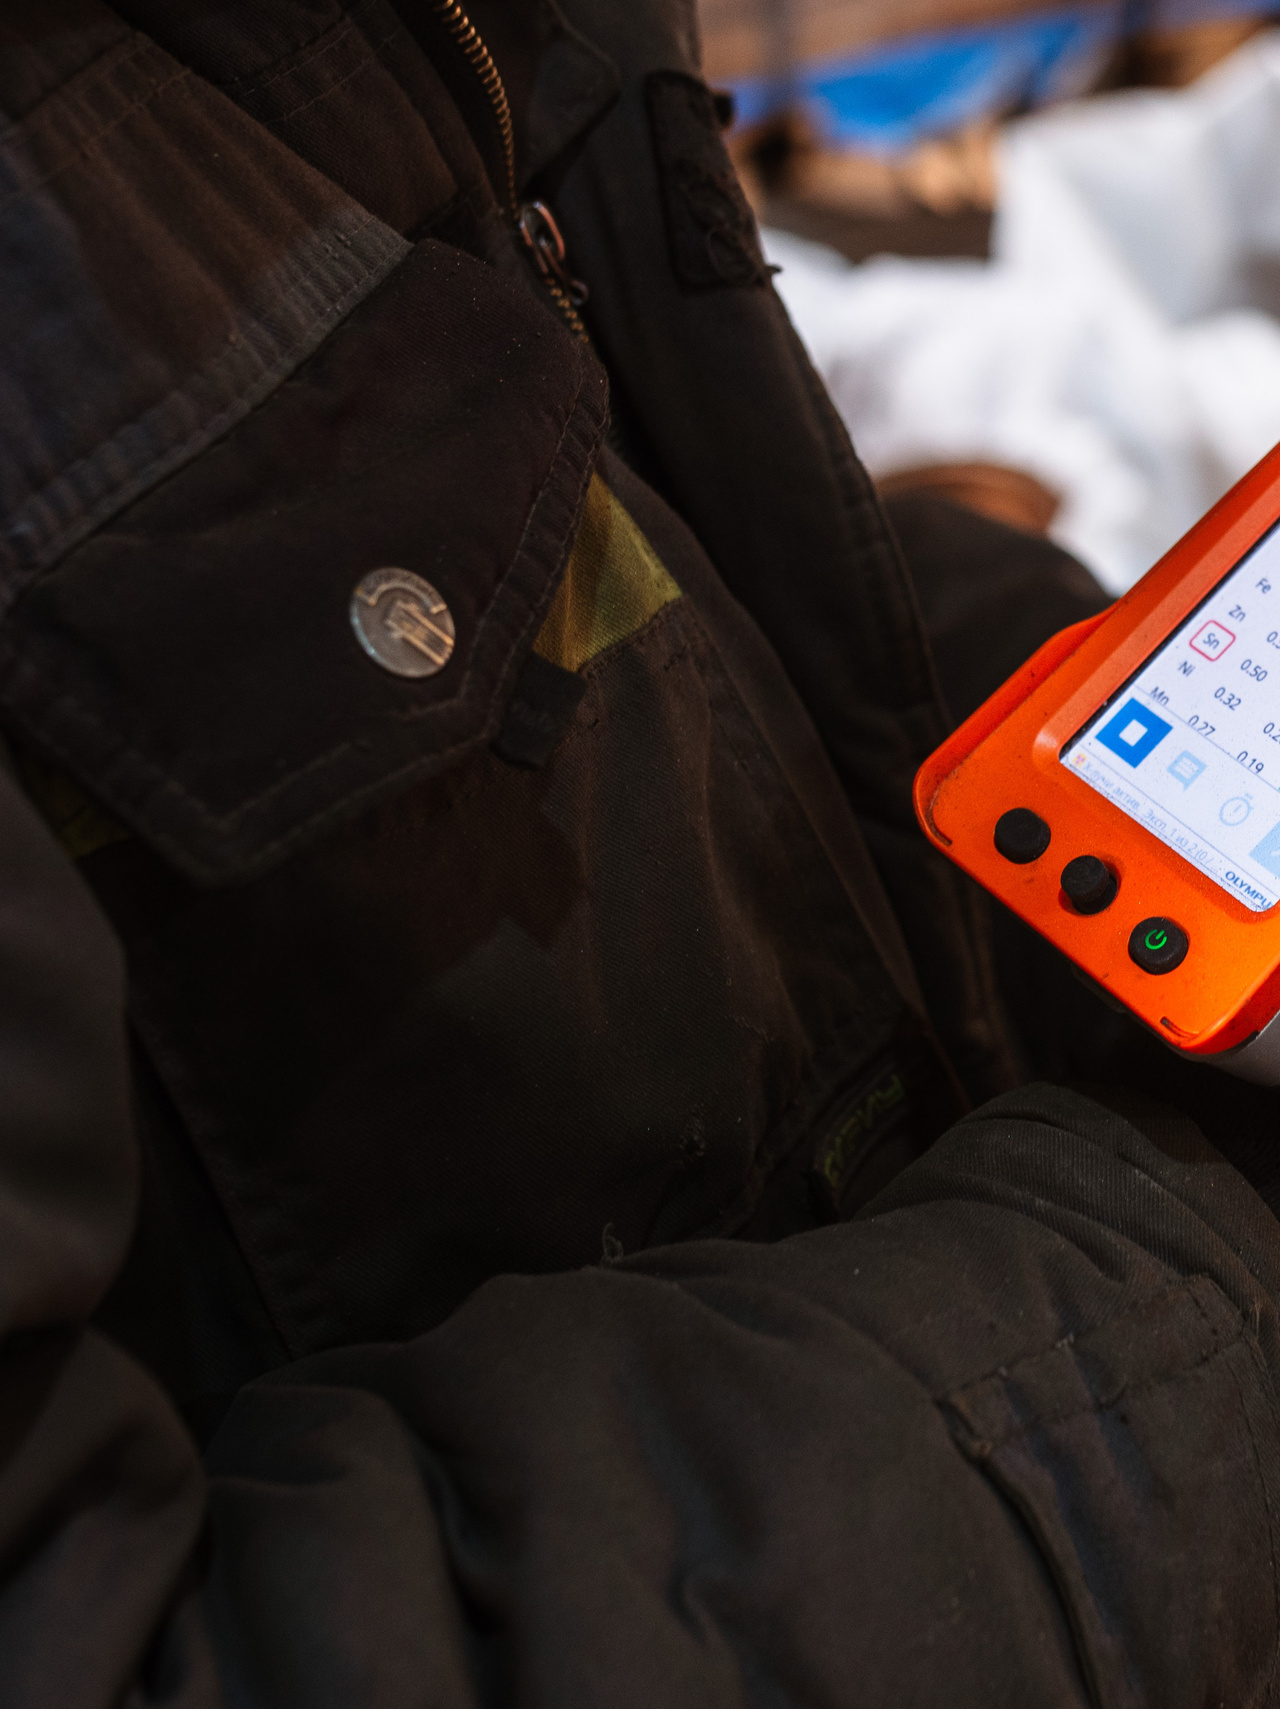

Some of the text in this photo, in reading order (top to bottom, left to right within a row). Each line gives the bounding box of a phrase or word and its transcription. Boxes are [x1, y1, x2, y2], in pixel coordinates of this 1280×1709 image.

[1255, 577, 1272, 594] Fe
[1228, 605, 1247, 623] Zn
[1203, 632, 1221, 650] Sn
[1240, 658, 1268, 683] 0.50
[1178, 660, 1196, 677] Ni
[1214, 687, 1242, 711] 0.32
[1150, 686, 1265, 774] Mn 0.27 0.19
